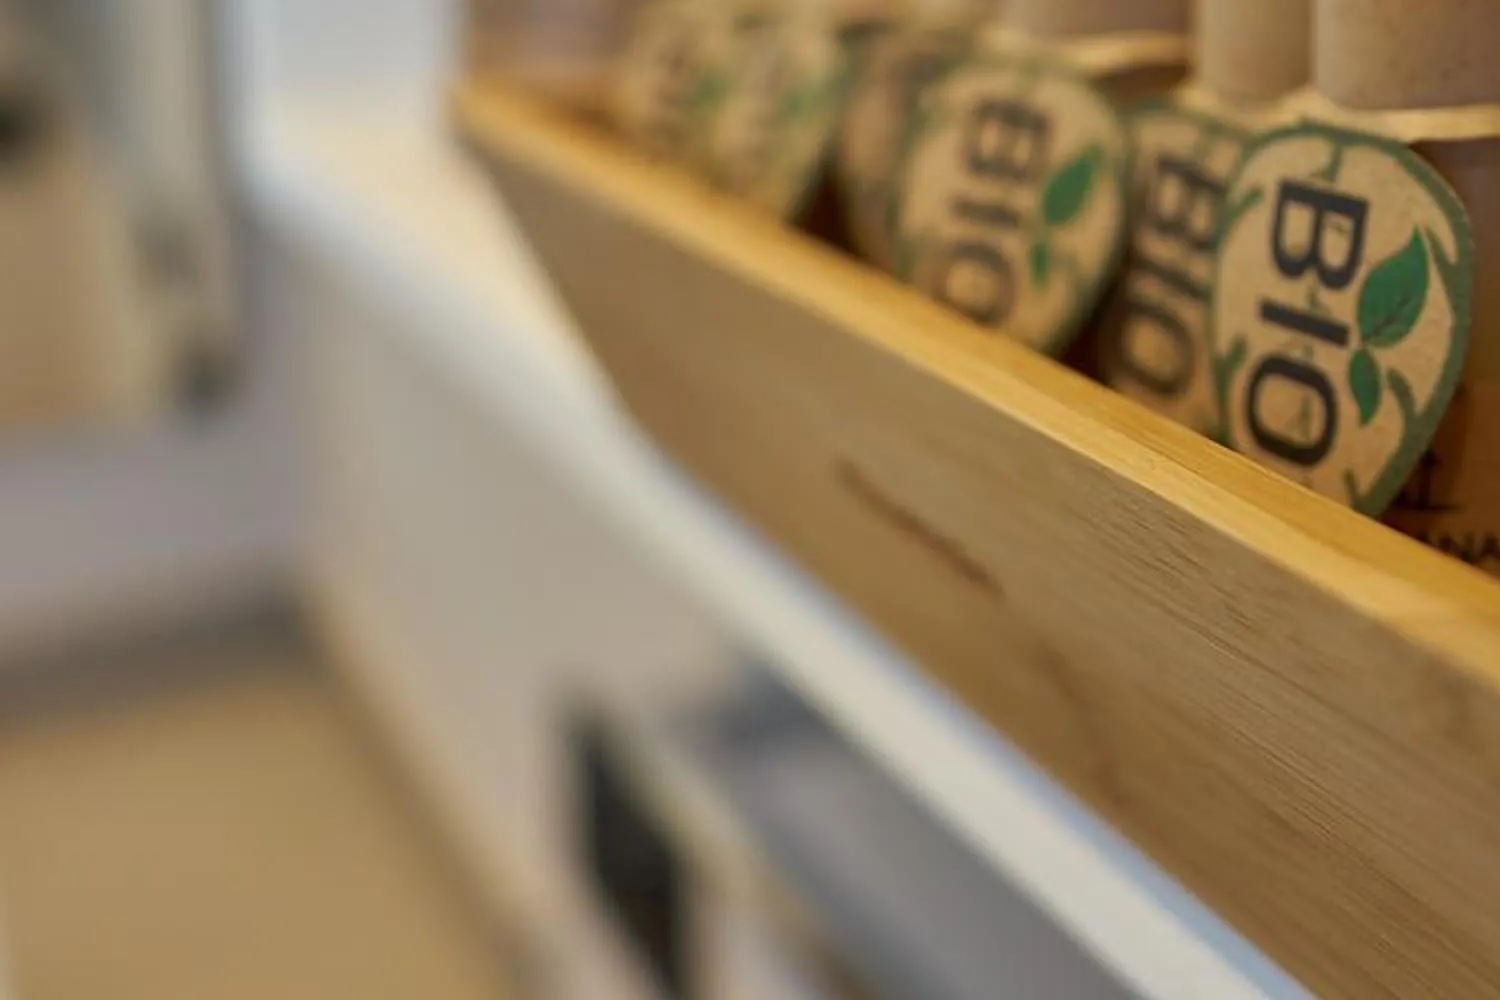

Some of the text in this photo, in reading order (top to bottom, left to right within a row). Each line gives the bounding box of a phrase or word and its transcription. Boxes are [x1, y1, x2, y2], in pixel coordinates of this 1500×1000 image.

[942, 99, 1050, 324] BIO
[1115, 155, 1226, 396] BIO
[1244, 180, 1369, 468] BIO
